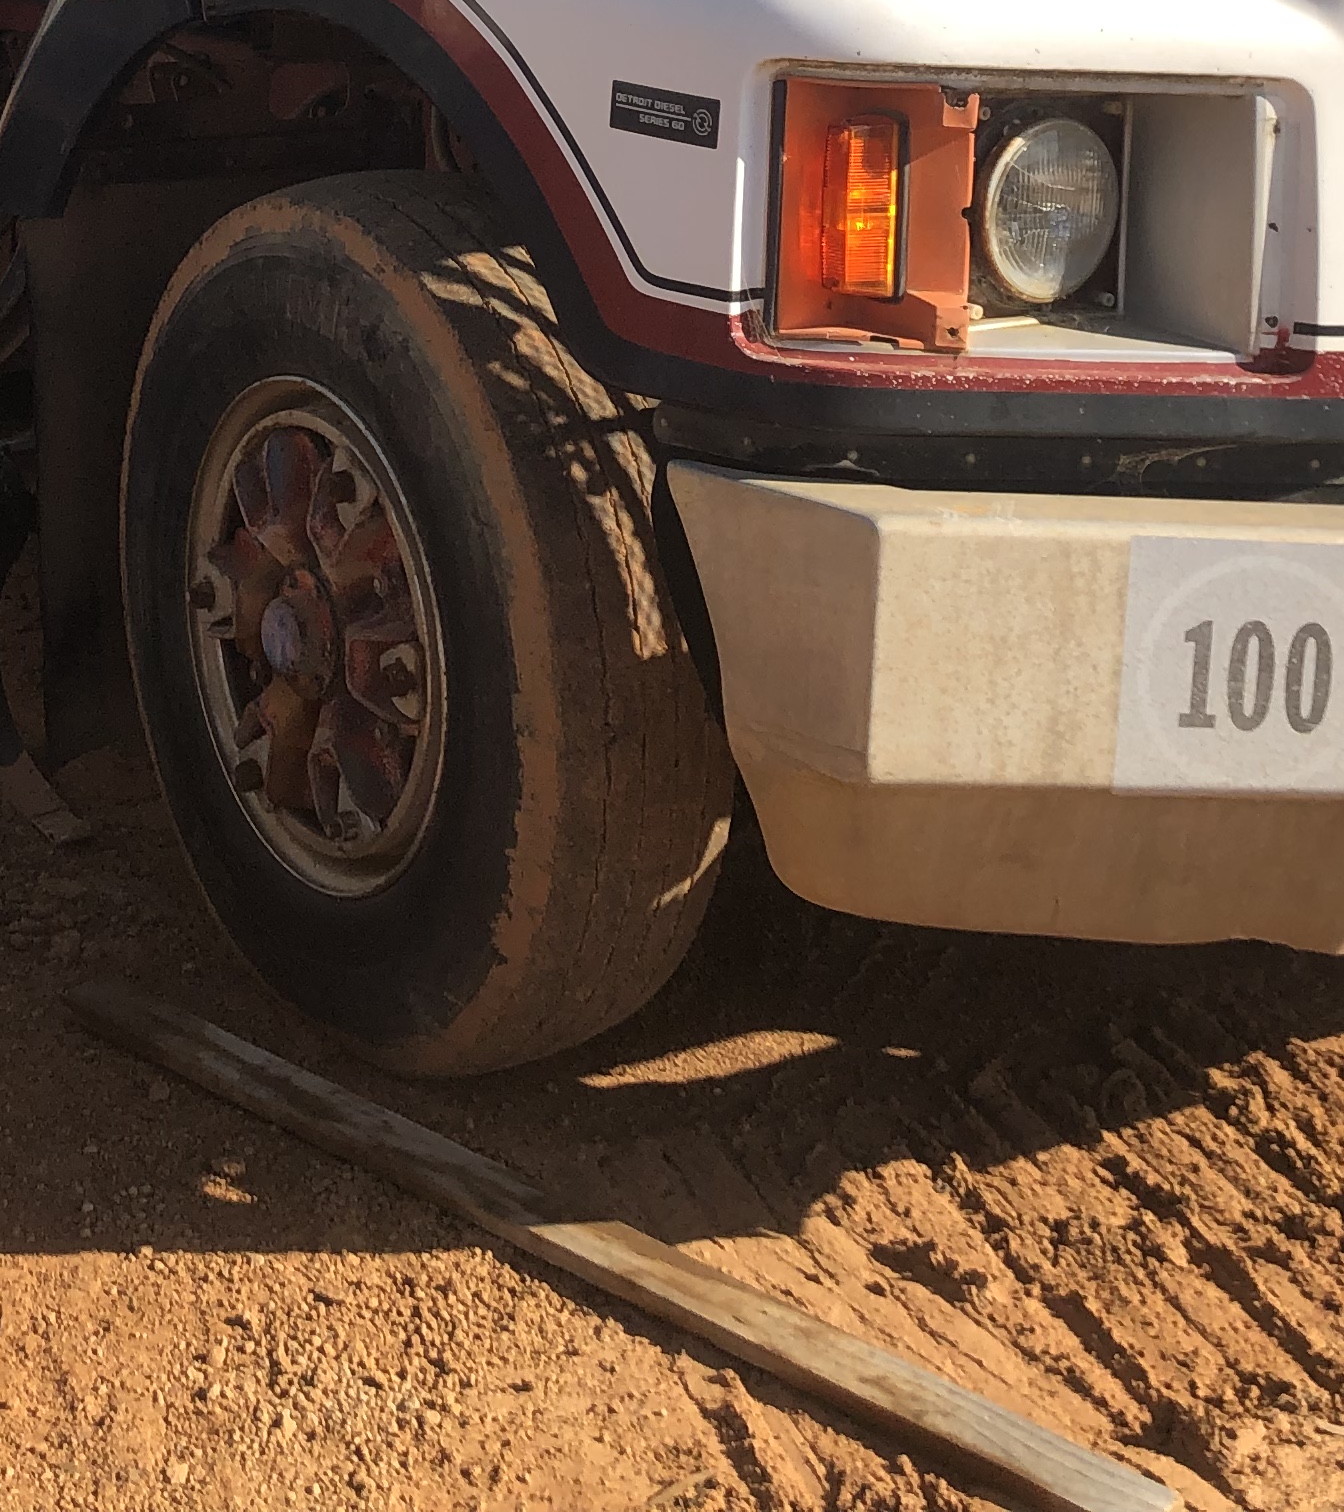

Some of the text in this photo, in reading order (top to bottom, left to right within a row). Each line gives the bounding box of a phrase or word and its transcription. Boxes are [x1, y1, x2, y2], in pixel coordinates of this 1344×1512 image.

[616, 92, 686, 114] DETROIT DIESEL
[639, 113, 685, 131] SERIES 60
[1178, 619, 1334, 734] 100
